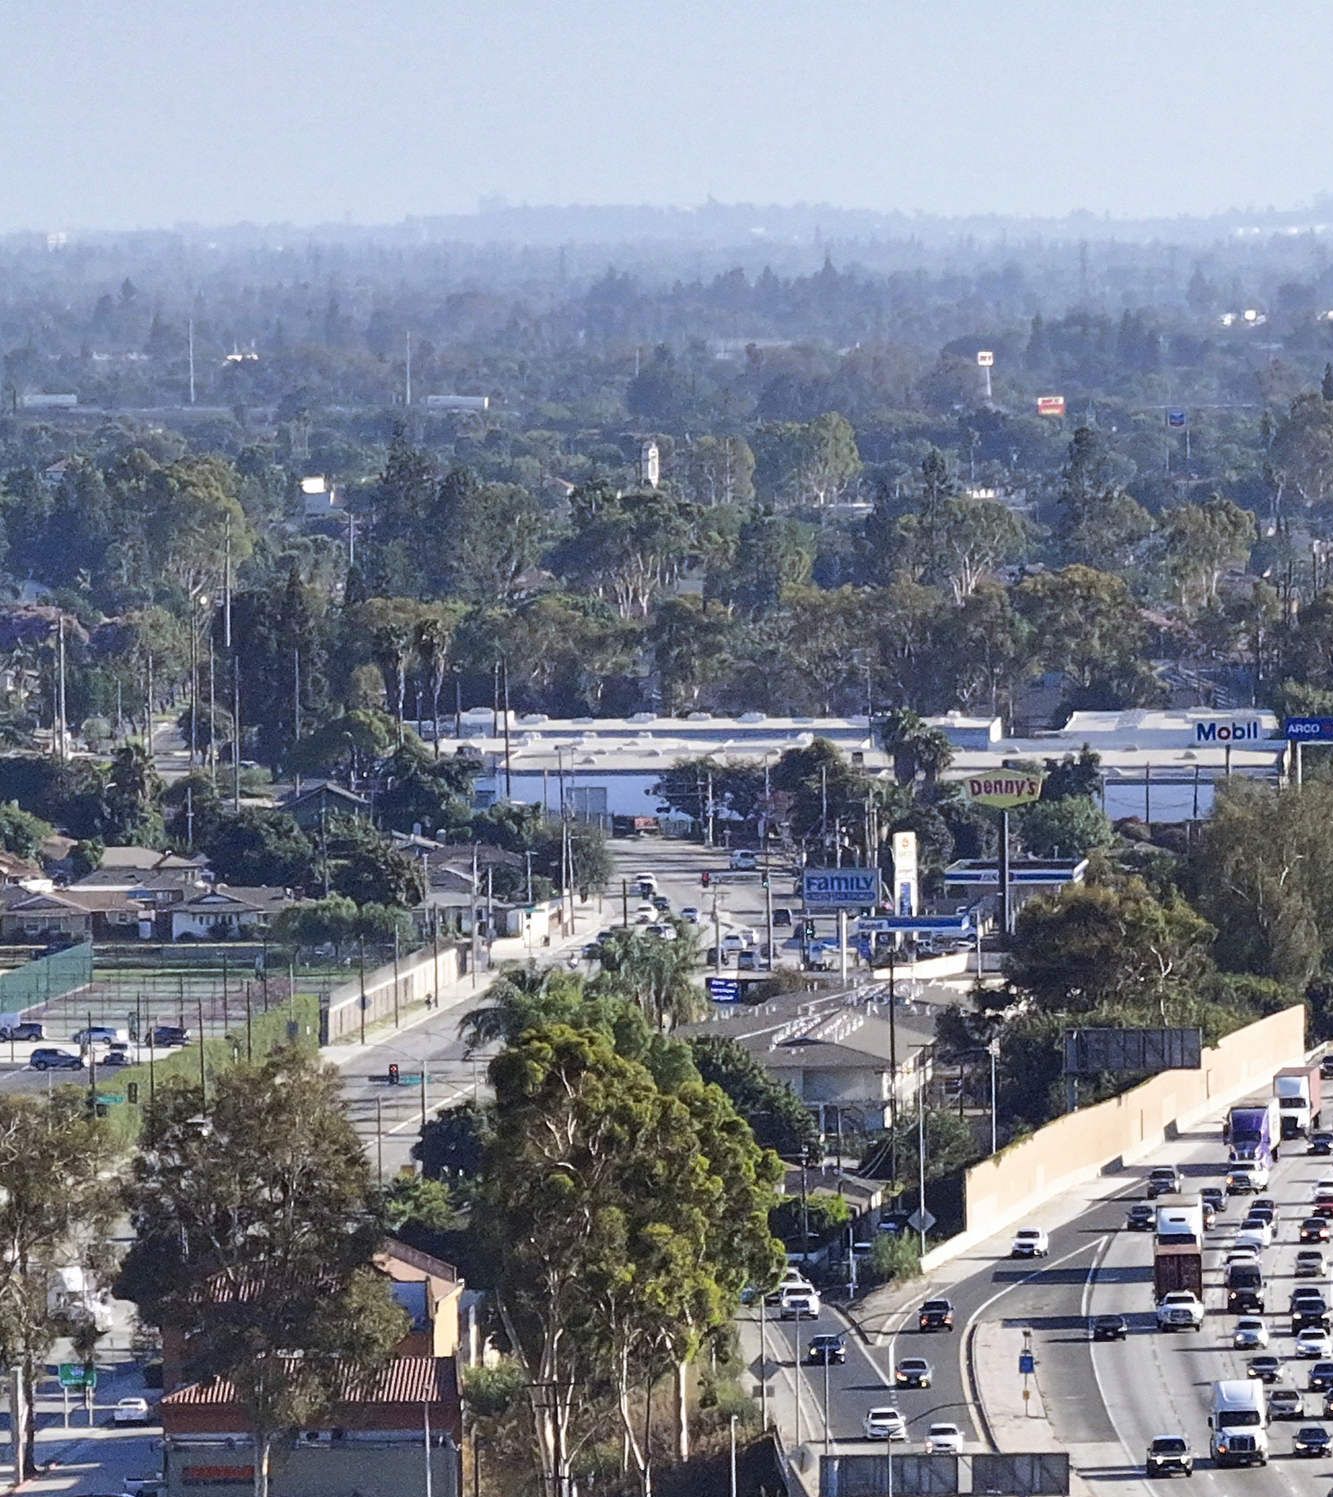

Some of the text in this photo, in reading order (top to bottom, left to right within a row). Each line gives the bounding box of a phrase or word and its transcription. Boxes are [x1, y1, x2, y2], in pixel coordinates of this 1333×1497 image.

[1197, 722, 1258, 741] Mobil
[1288, 724, 1320, 734] ARCO
[969, 778, 1038, 797] Denny's
